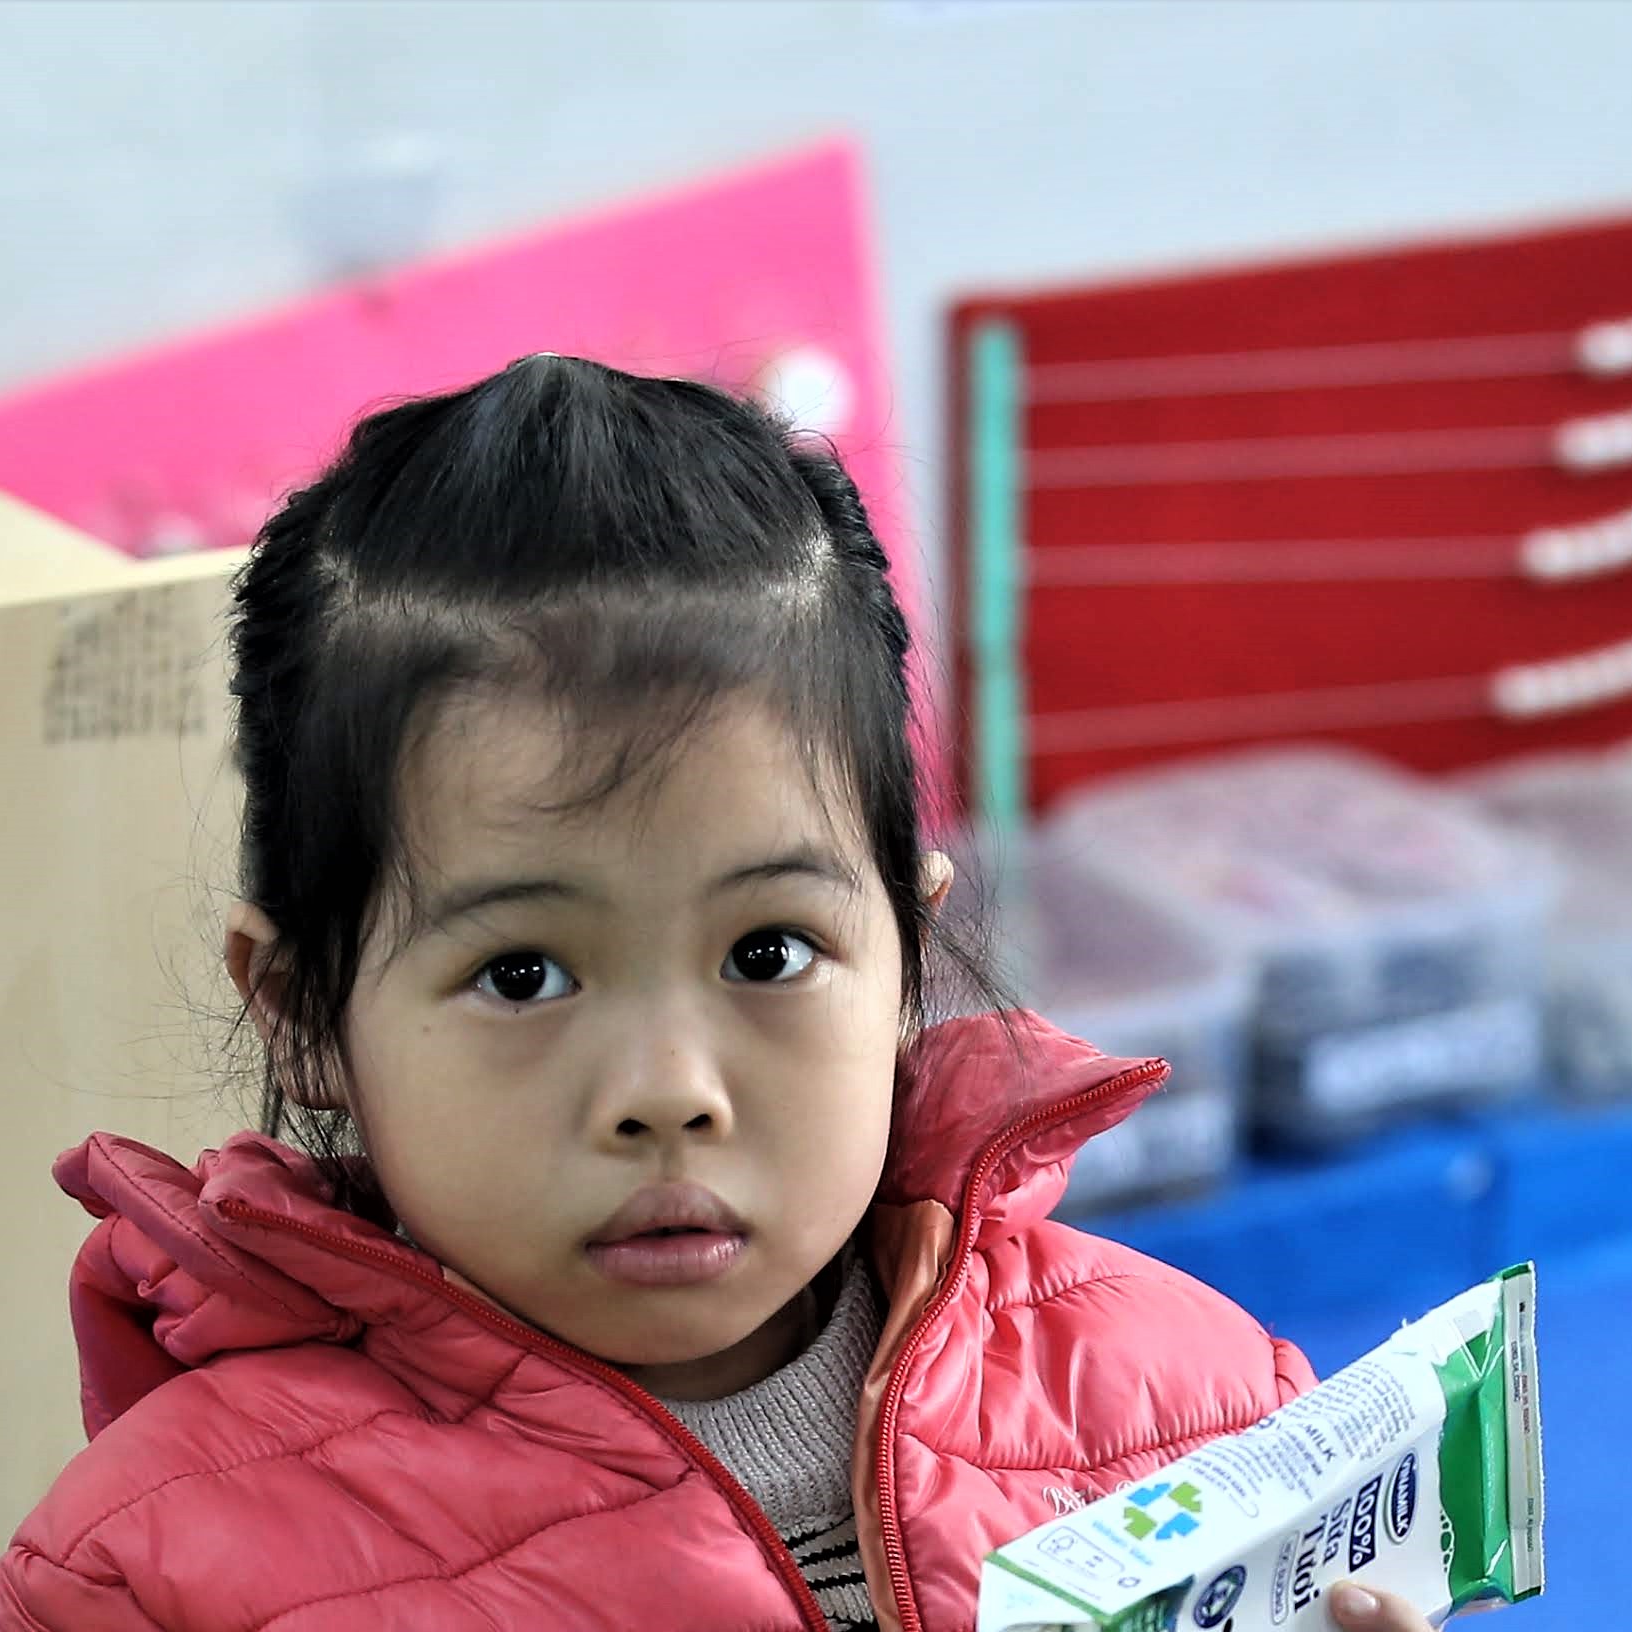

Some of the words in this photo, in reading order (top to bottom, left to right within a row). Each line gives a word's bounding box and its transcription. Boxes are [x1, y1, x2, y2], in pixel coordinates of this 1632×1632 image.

[1294, 1513, 1328, 1614] Tươi
[1323, 1497, 1353, 1566] Sữa
[1352, 1480, 1380, 1566] 100%
